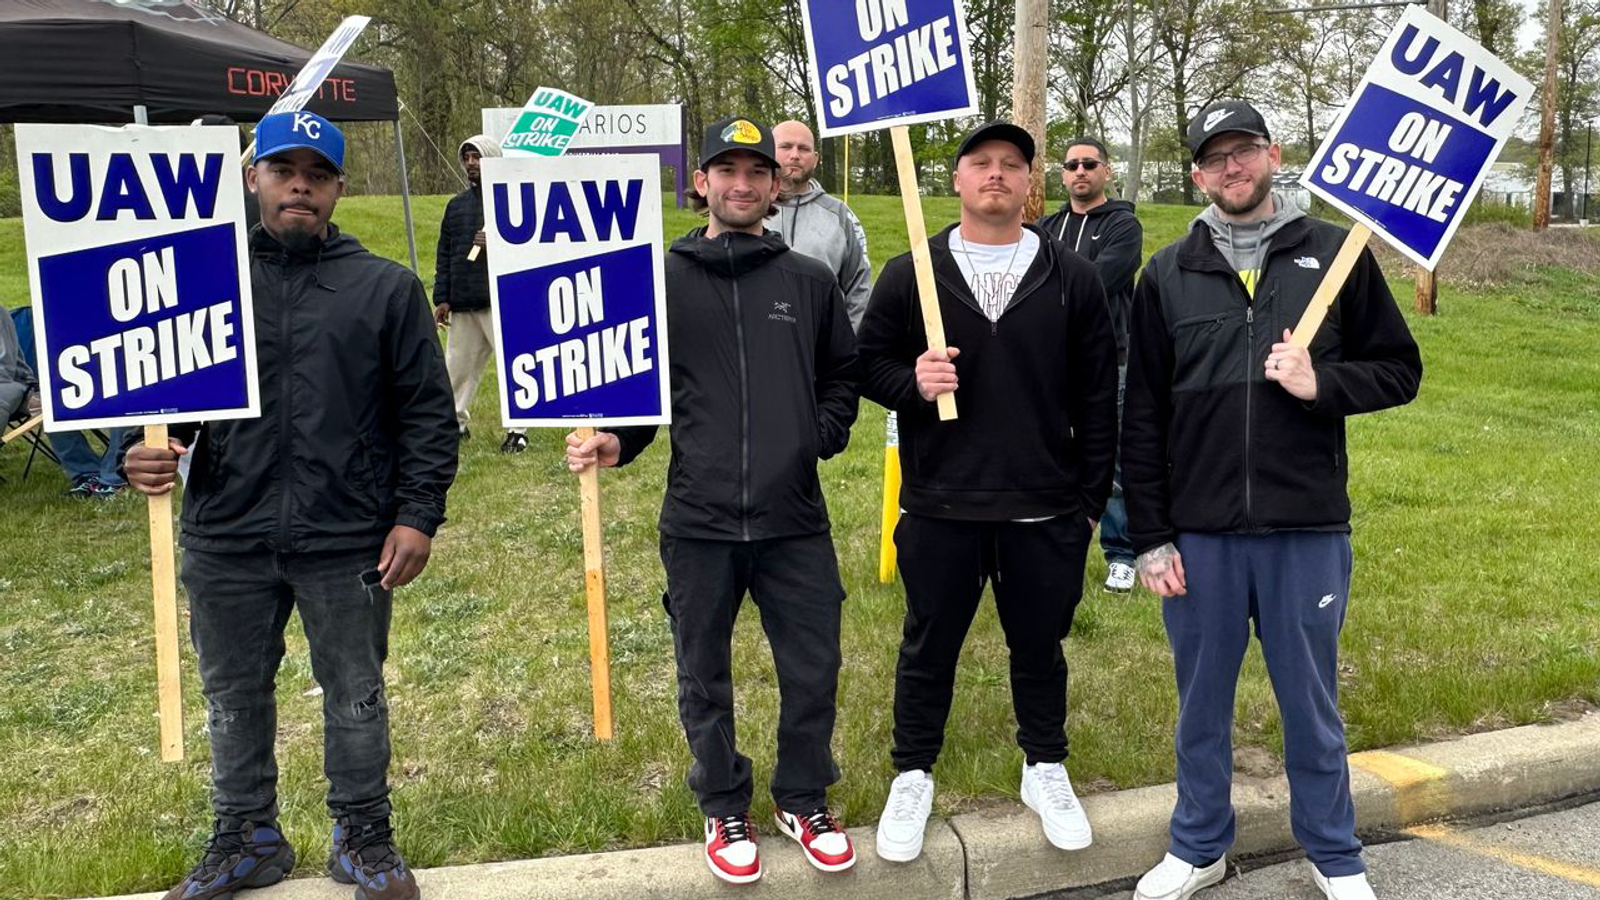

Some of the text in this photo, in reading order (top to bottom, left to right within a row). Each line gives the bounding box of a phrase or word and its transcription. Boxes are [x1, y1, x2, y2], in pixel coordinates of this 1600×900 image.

[855, 0, 909, 42] ON
[227, 67, 356, 102] CORVTTE
[826, 16, 957, 118] STRIKE
[1391, 23, 1518, 128] UAW
[292, 113, 321, 139] KC
[530, 116, 559, 132] ON
[533, 91, 588, 119] UAW
[1387, 111, 1453, 164] ON
[503, 131, 572, 149] STRIKE
[32, 152, 224, 222] UAW
[492, 179, 644, 245] UAW
[1321, 142, 1465, 224] STRIKE
[107, 246, 179, 322] ON
[548, 266, 604, 335] ON
[969, 271, 1022, 319] ANG
[58, 300, 237, 410] STRIKE
[511, 315, 653, 410] STRIKE
